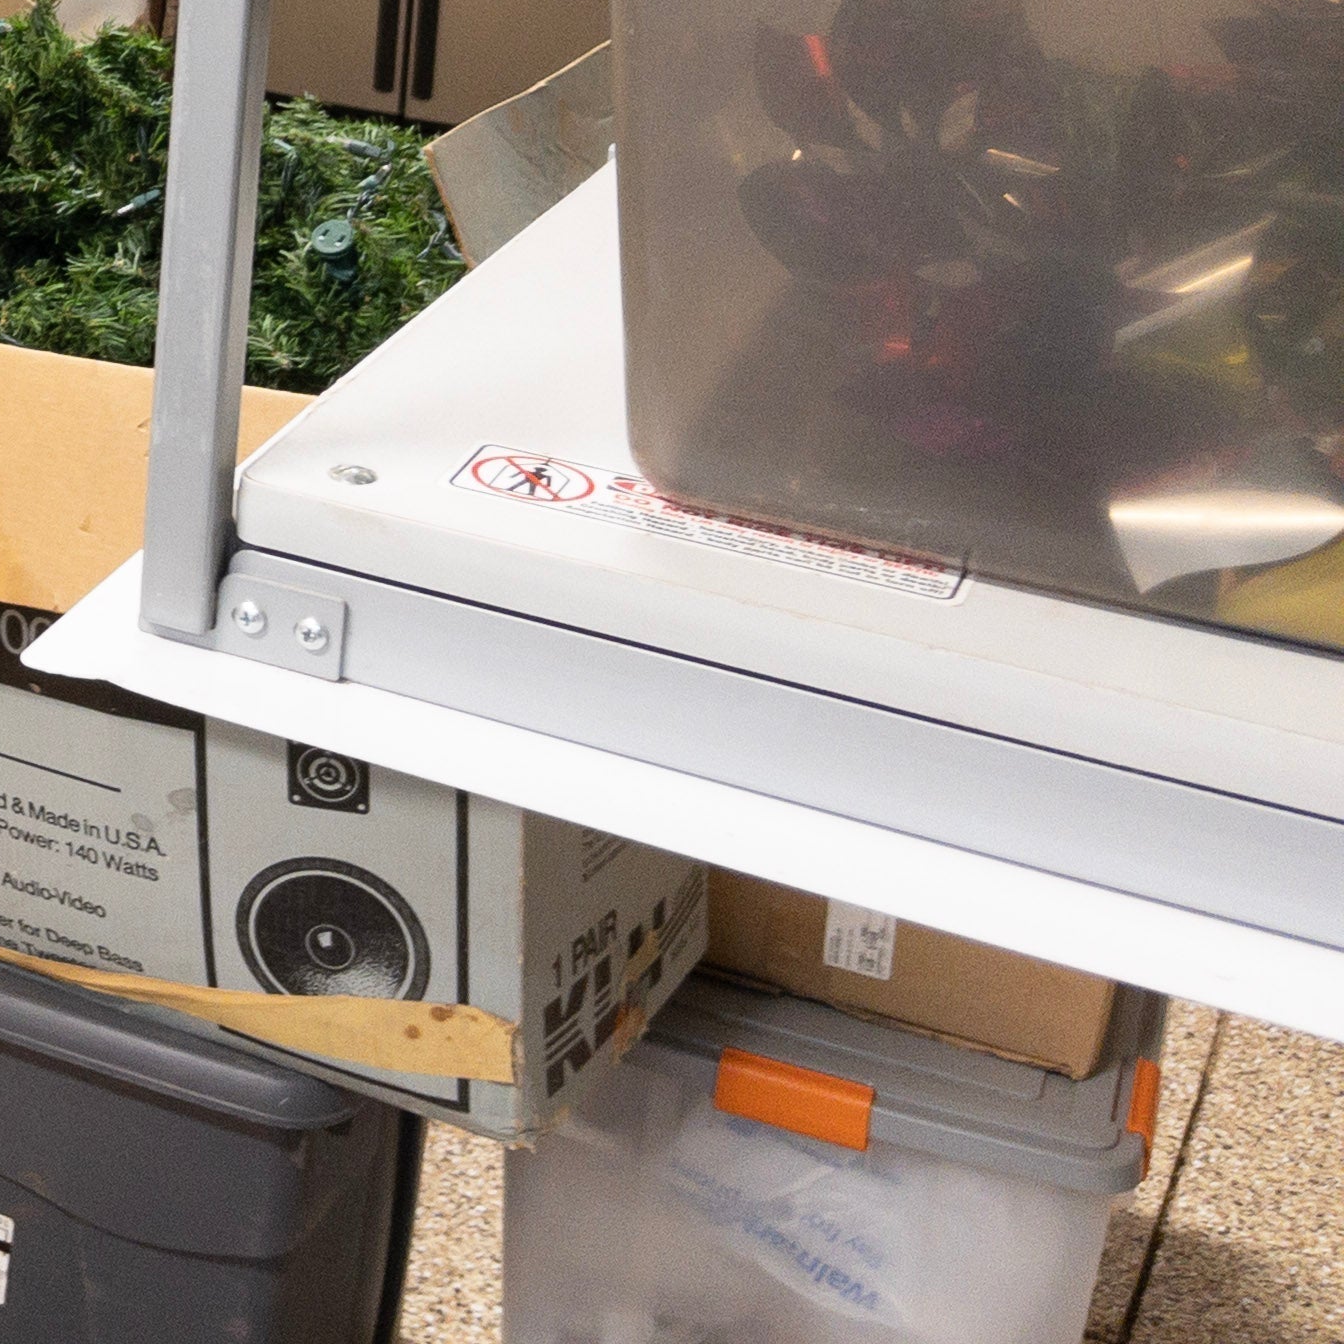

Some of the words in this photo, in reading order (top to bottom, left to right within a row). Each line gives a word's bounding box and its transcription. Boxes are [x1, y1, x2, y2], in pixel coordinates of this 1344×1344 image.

[12, 797, 25, 816] &
[28, 801, 81, 832] Made
[83, 819, 101, 839] in
[104, 825, 167, 857] U.S.A.
[65, 842, 98, 864] 140
[103, 851, 160, 882] Watts
[1, 872, 107, 918] Audio-Video
[17, 919, 41, 937] for
[44, 928, 95, 956] Deep
[97, 945, 144, 972] Bass
[552, 952, 561, 988] 1
[572, 908, 618, 977] PAIR
